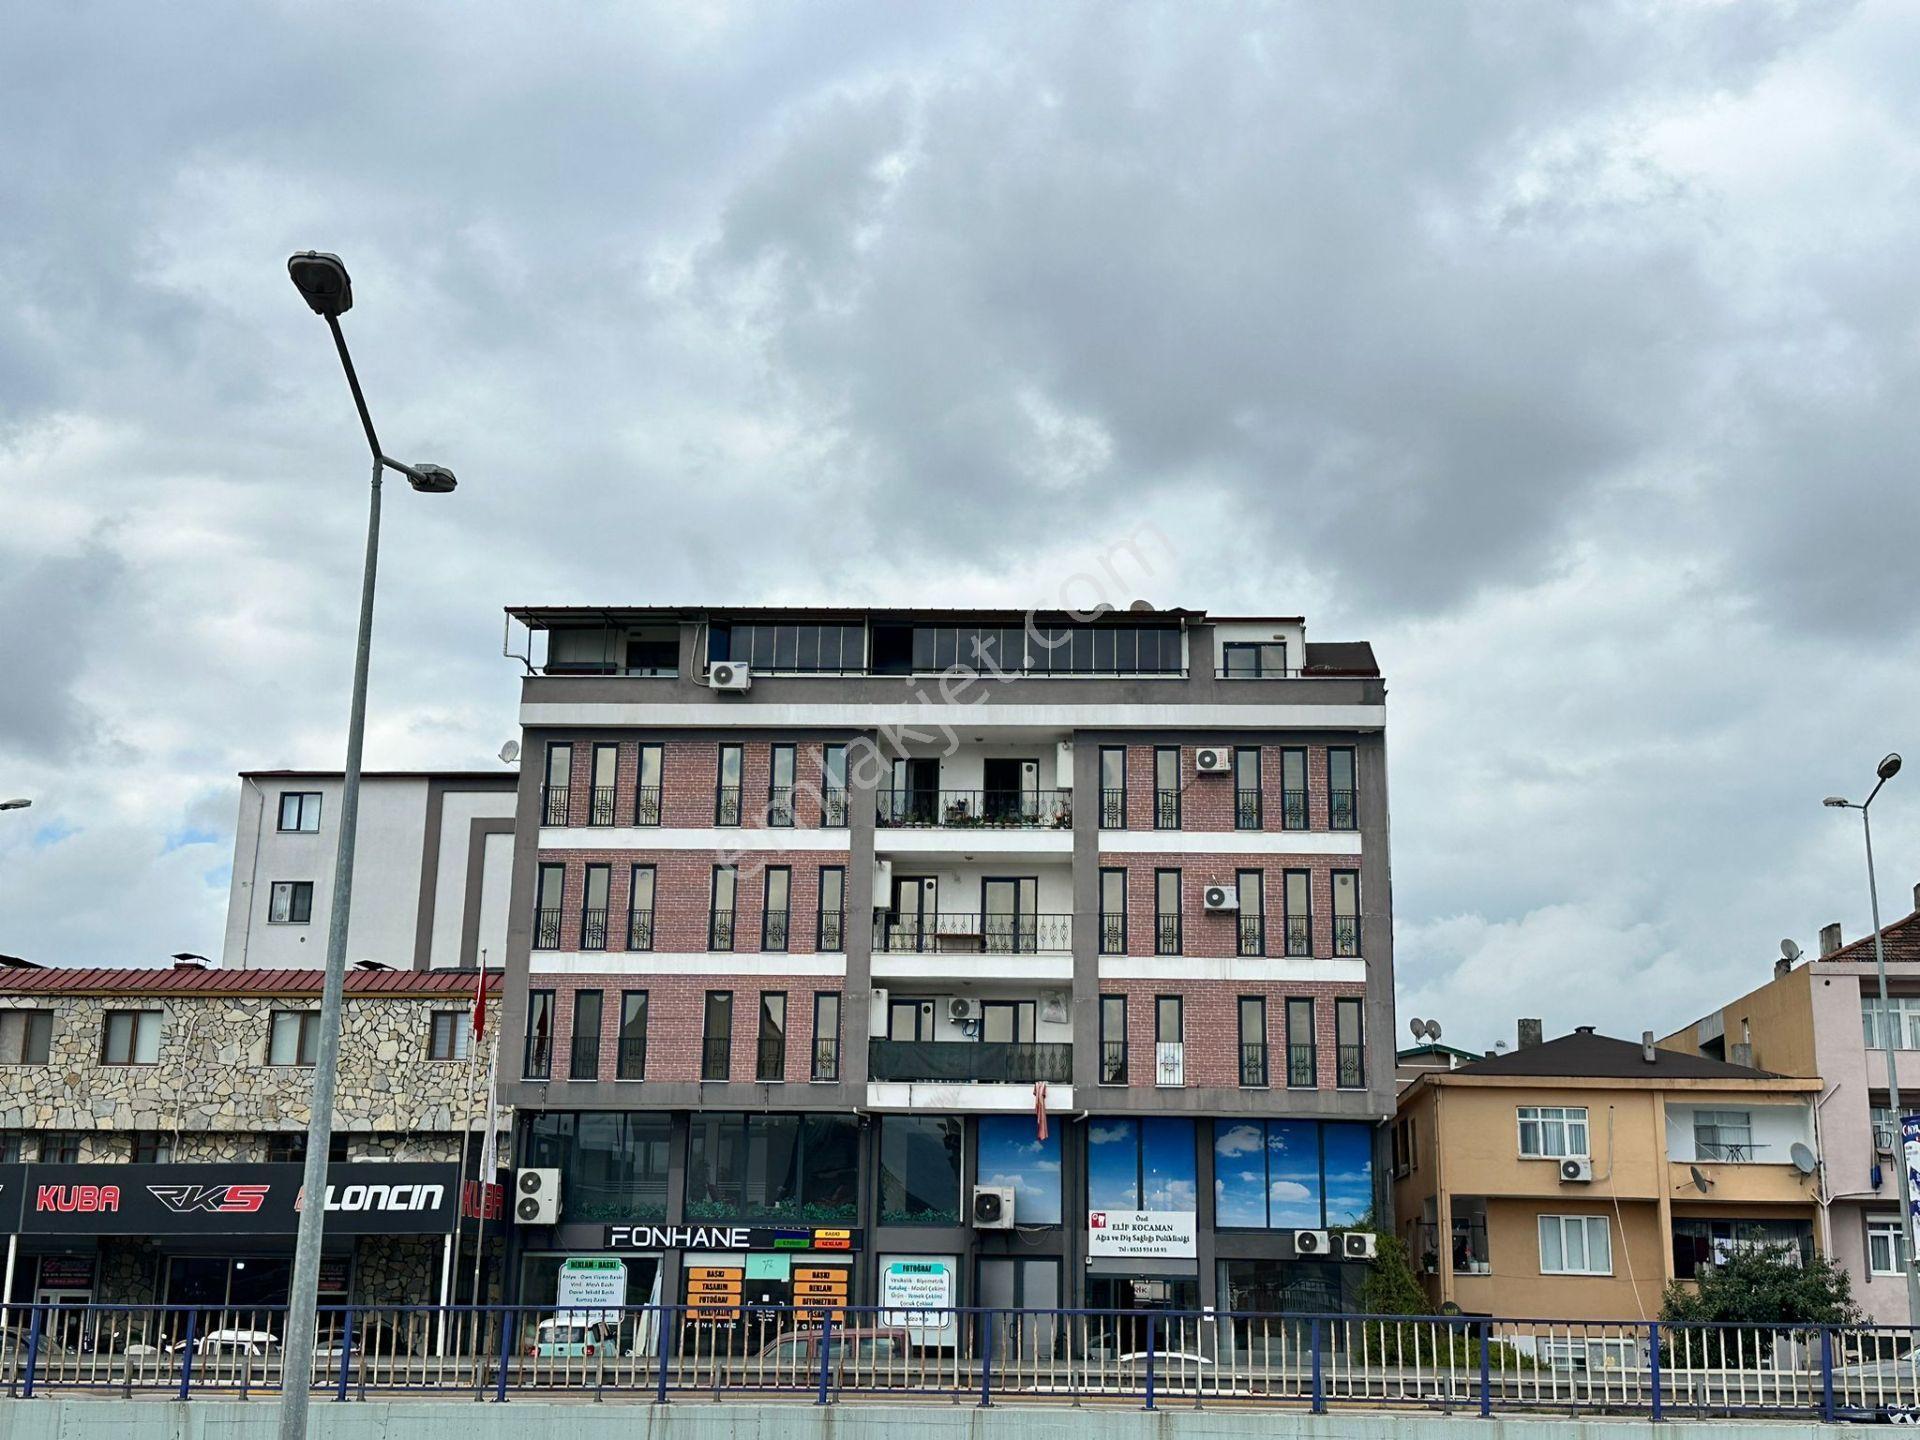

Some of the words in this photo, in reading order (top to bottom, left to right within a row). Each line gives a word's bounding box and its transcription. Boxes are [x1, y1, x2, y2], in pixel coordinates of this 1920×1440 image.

[36, 1185, 120, 1212] KUBA
[146, 1185, 270, 1212] RKS
[324, 1184, 445, 1211] LONCIN
[462, 1179, 504, 1220] KUBA
[611, 1226, 750, 1248] FONHANE
[1112, 1223, 1129, 1231] ELİF
[1132, 1224, 1173, 1232] KOCAMAN
[706, 1270, 725, 1278] BASKI
[812, 1271, 831, 1279] BASKI
